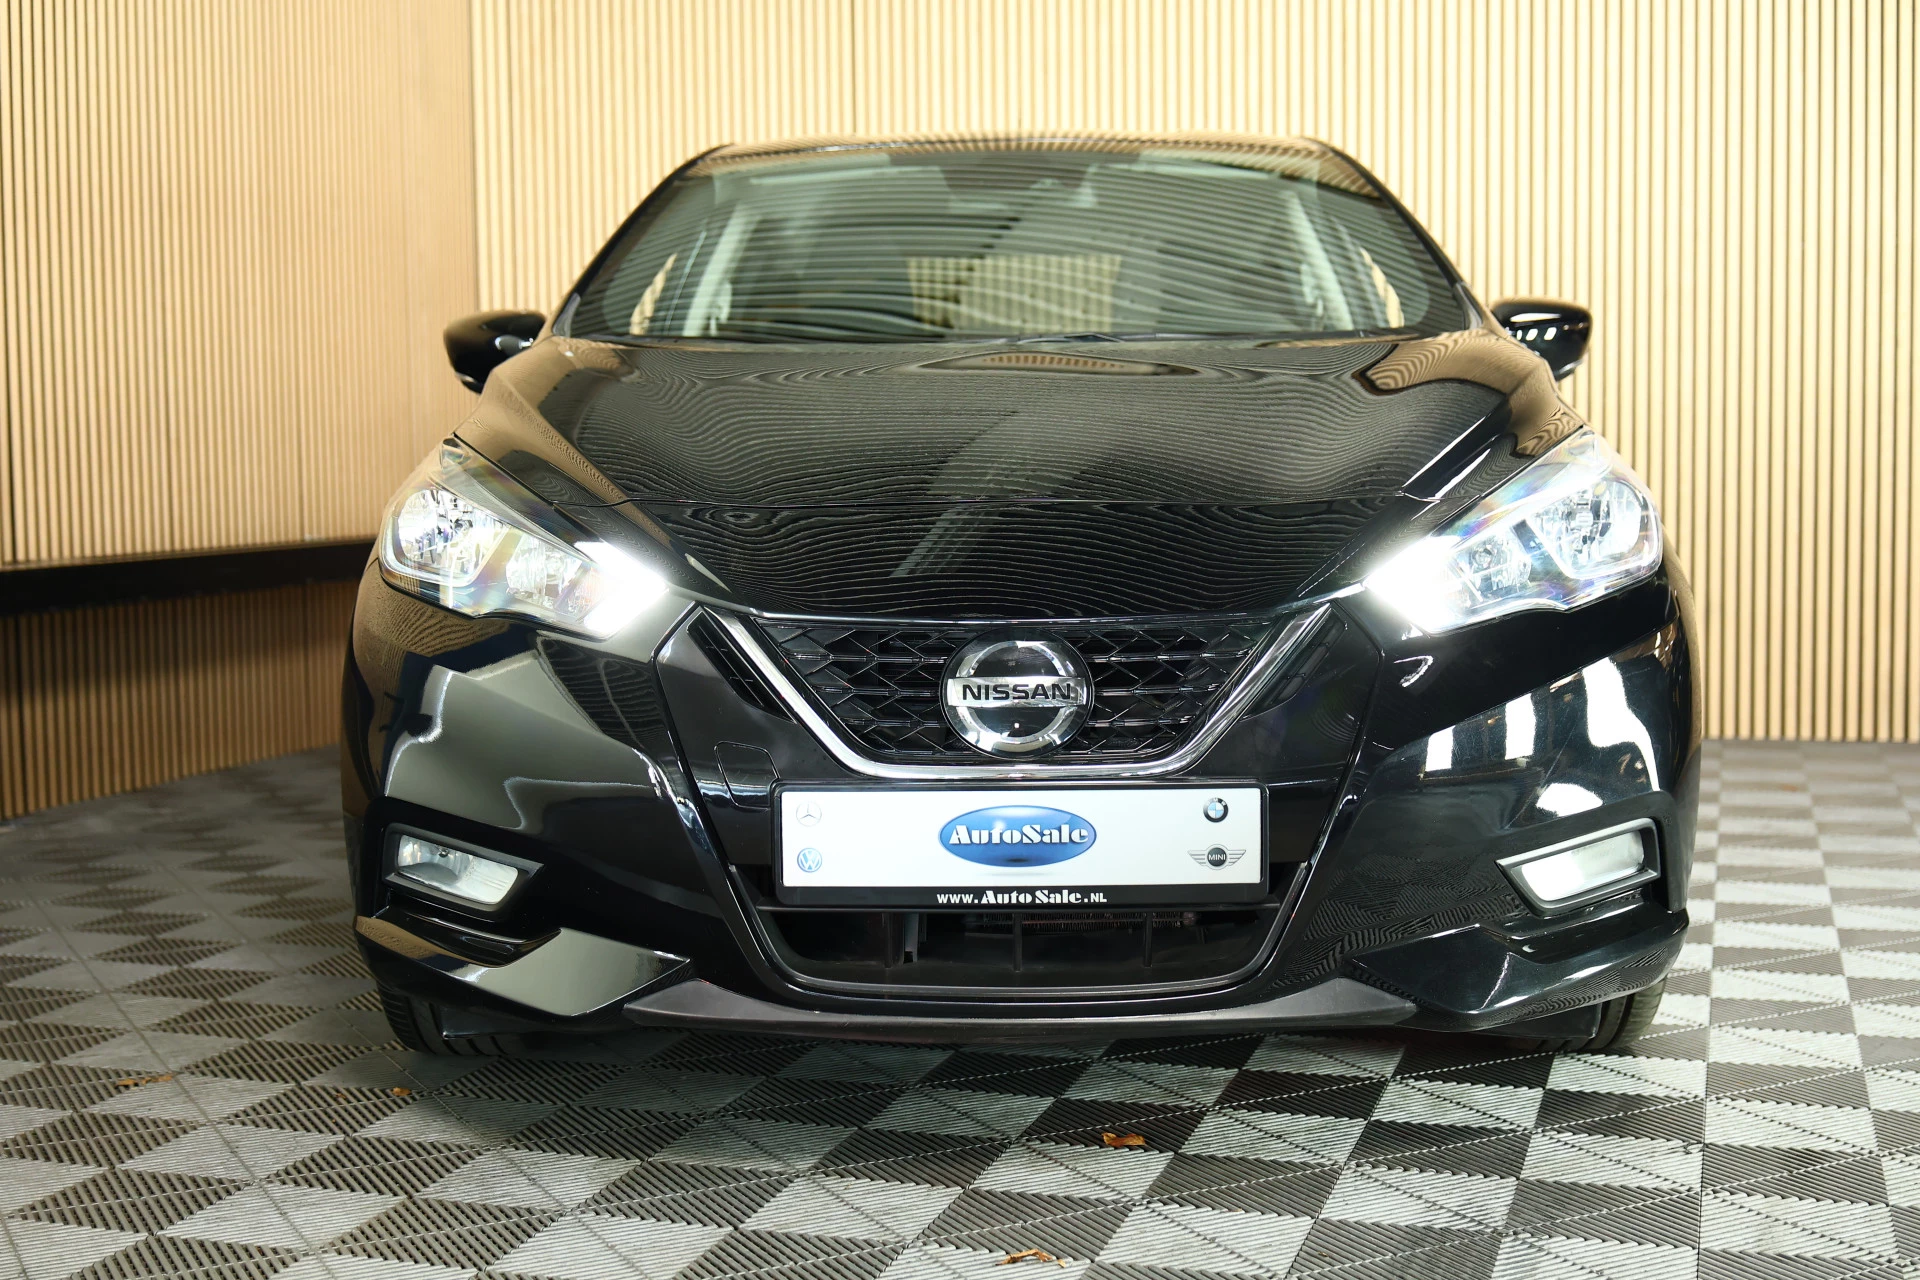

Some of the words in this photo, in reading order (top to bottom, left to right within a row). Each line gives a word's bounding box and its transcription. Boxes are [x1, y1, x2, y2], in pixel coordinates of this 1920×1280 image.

[962, 683, 1071, 700] NISSAN
[949, 824, 1089, 844] AutoSale
[1208, 853, 1226, 861] MINI
